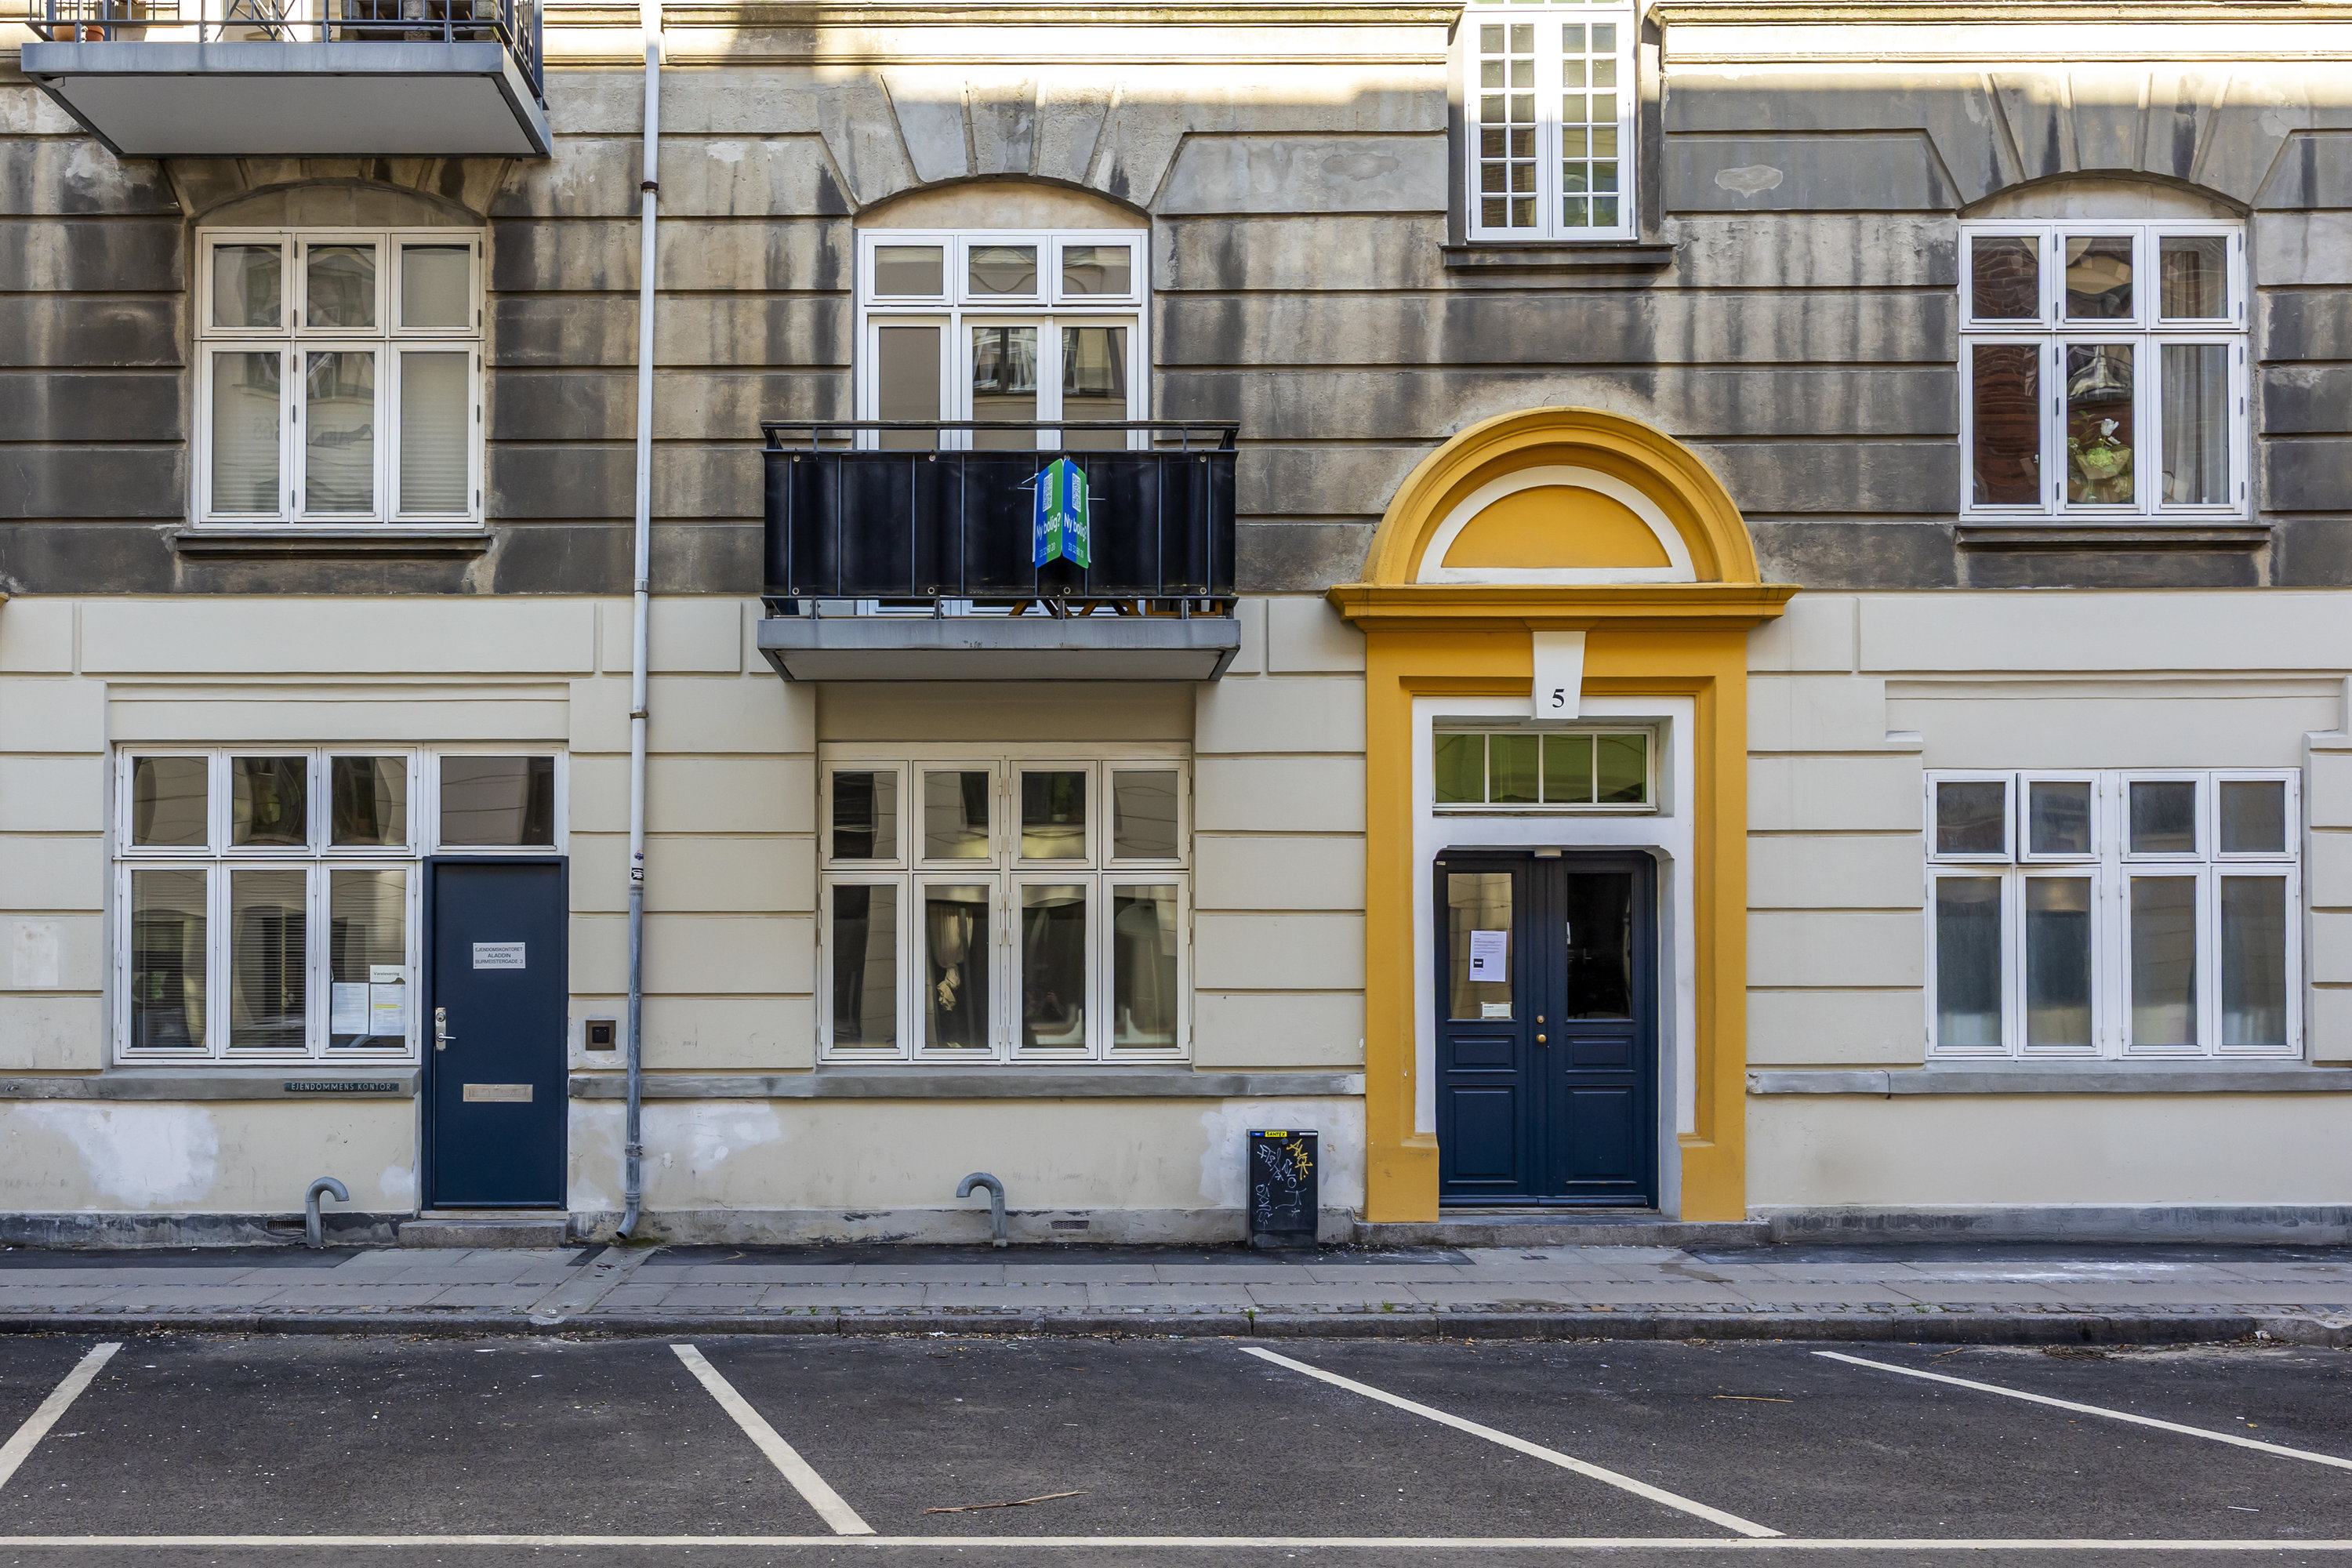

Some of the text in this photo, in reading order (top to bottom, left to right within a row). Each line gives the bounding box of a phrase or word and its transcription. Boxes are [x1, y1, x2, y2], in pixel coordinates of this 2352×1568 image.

[1036, 512, 1061, 541] Ny bolig?
[1064, 512, 1073, 533] Ny
[1552, 688, 1565, 708] 5
